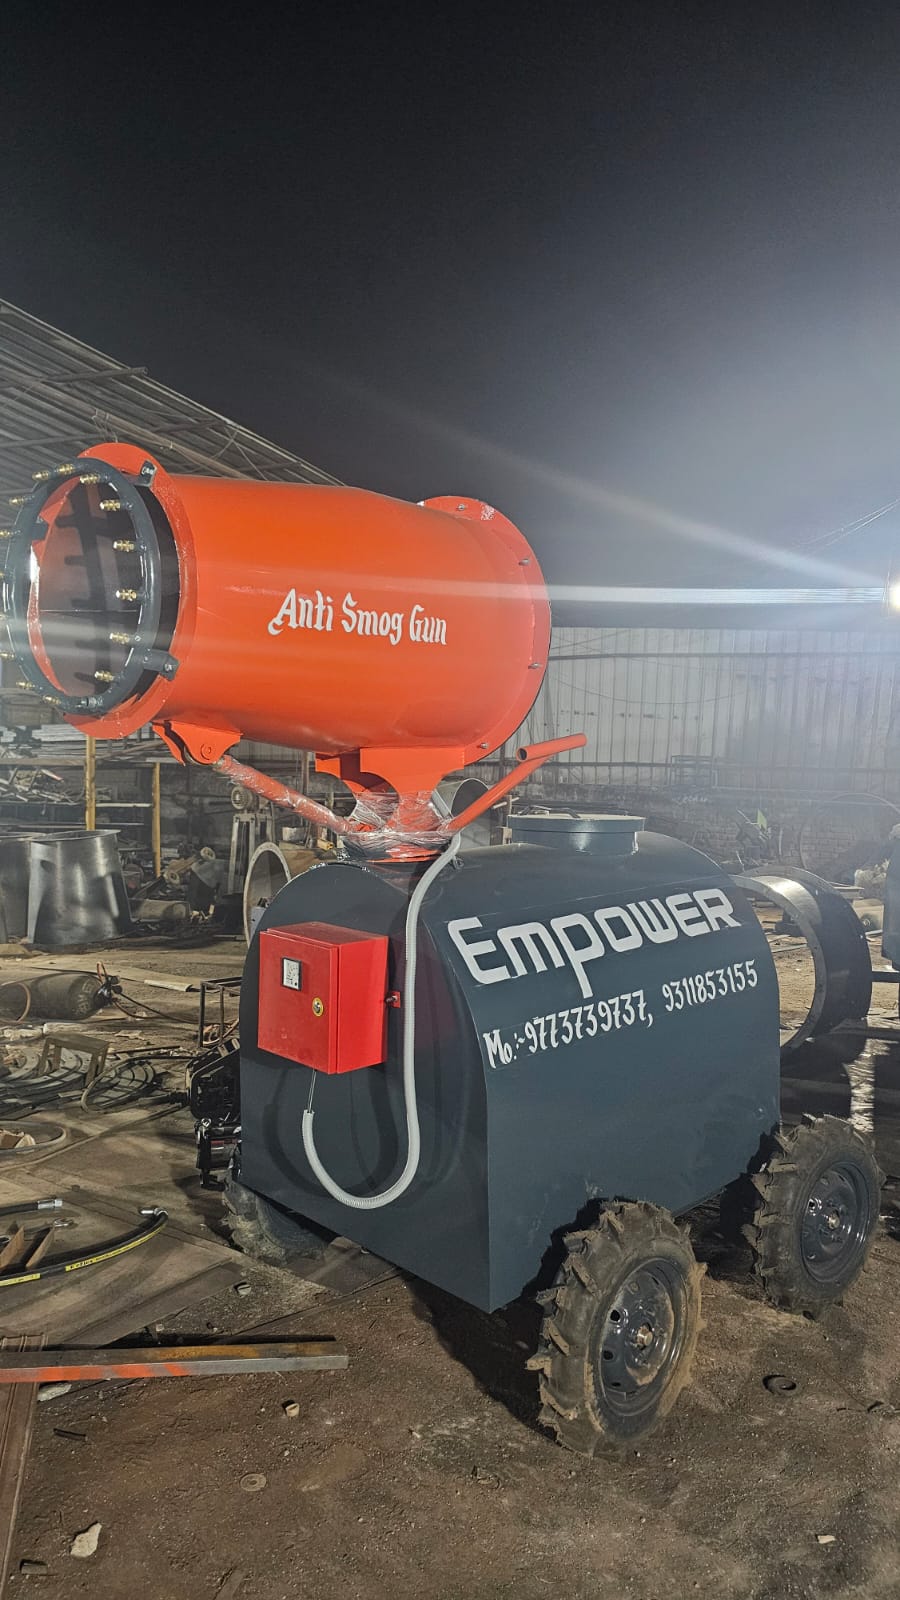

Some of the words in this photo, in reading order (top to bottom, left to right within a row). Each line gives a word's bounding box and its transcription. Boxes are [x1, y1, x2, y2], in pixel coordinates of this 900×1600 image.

[267, 588, 334, 635] Anti
[341, 592, 404, 646] Smog
[409, 604, 447, 645] Gun
[661, 959, 758, 1012] 9311853155
